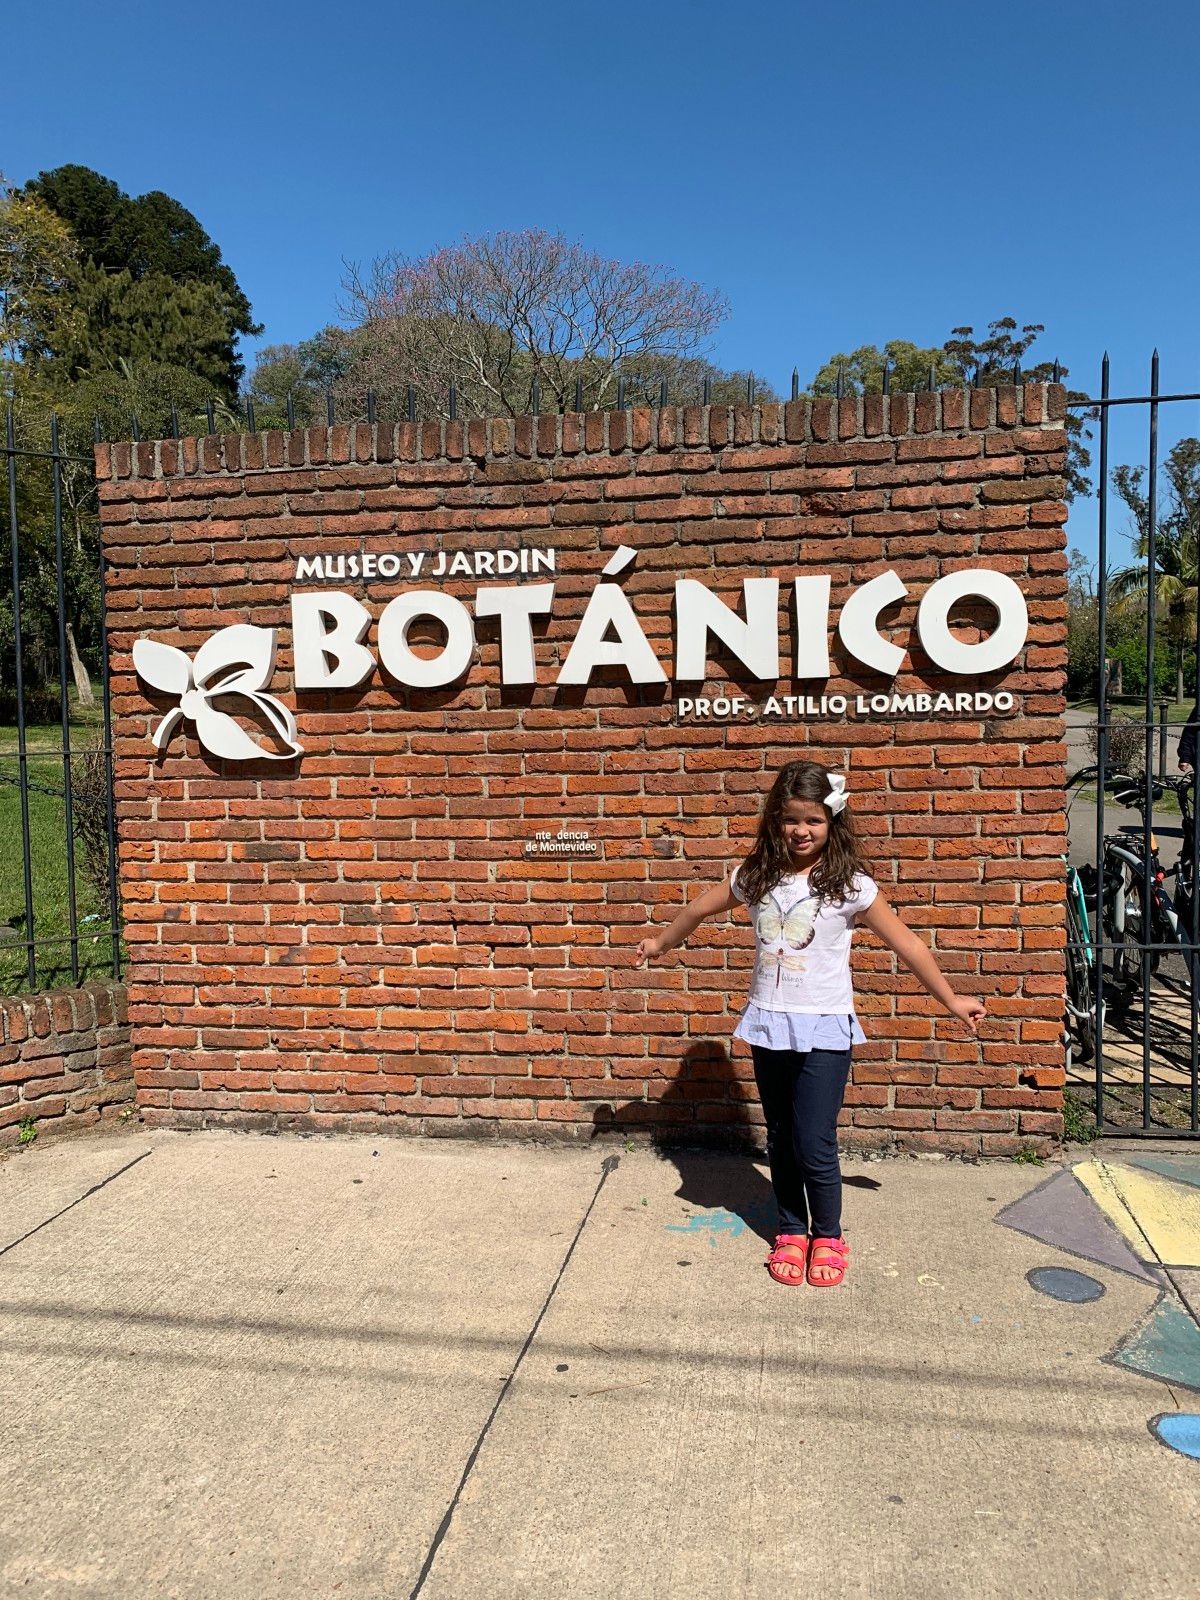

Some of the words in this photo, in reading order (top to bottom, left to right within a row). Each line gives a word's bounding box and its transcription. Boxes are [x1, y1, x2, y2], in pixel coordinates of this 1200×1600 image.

[295, 553, 401, 580] MUSEO
[407, 552, 426, 577] Y
[432, 548, 556, 576] JARDIN
[291, 545, 1029, 688] BOTÁNICO
[678, 697, 755, 716] PROF.
[763, 695, 848, 715] ATILIO
[856, 691, 1014, 714] LOMBARDO
[525, 841, 538, 851] de
[540, 841, 597, 851] Montevideo
